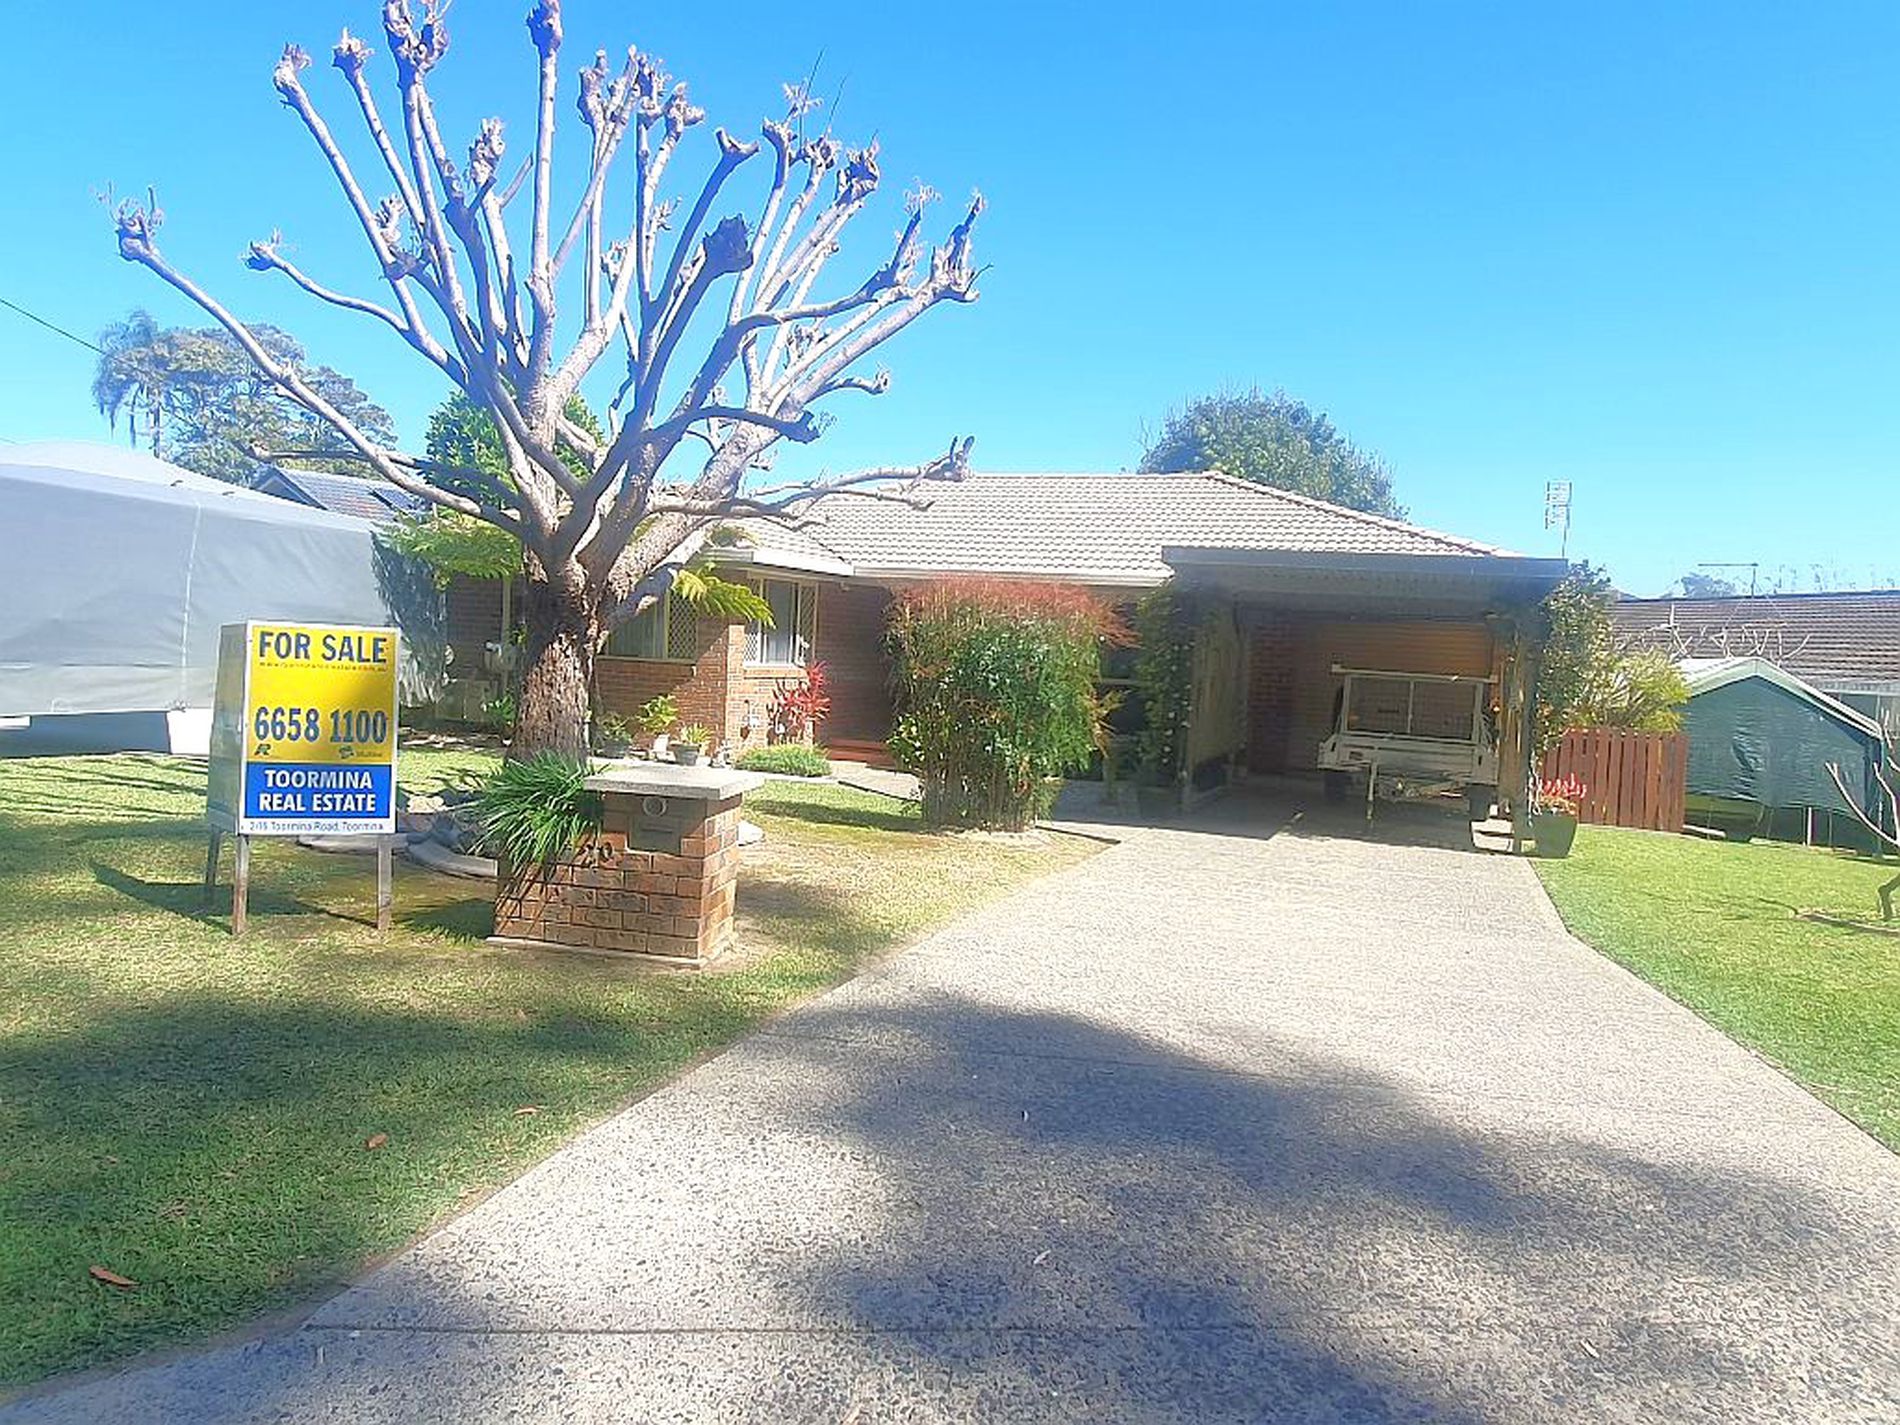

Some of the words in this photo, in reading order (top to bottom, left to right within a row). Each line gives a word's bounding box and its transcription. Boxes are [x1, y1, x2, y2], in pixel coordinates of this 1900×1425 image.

[259, 631, 311, 660] FOR
[321, 634, 387, 663] SALE
[254, 706, 320, 741] 6658
[329, 709, 387, 743] 1100
[264, 769, 373, 789] TOORMINA
[259, 793, 306, 811] REAL
[312, 793, 376, 812] ESTATE
